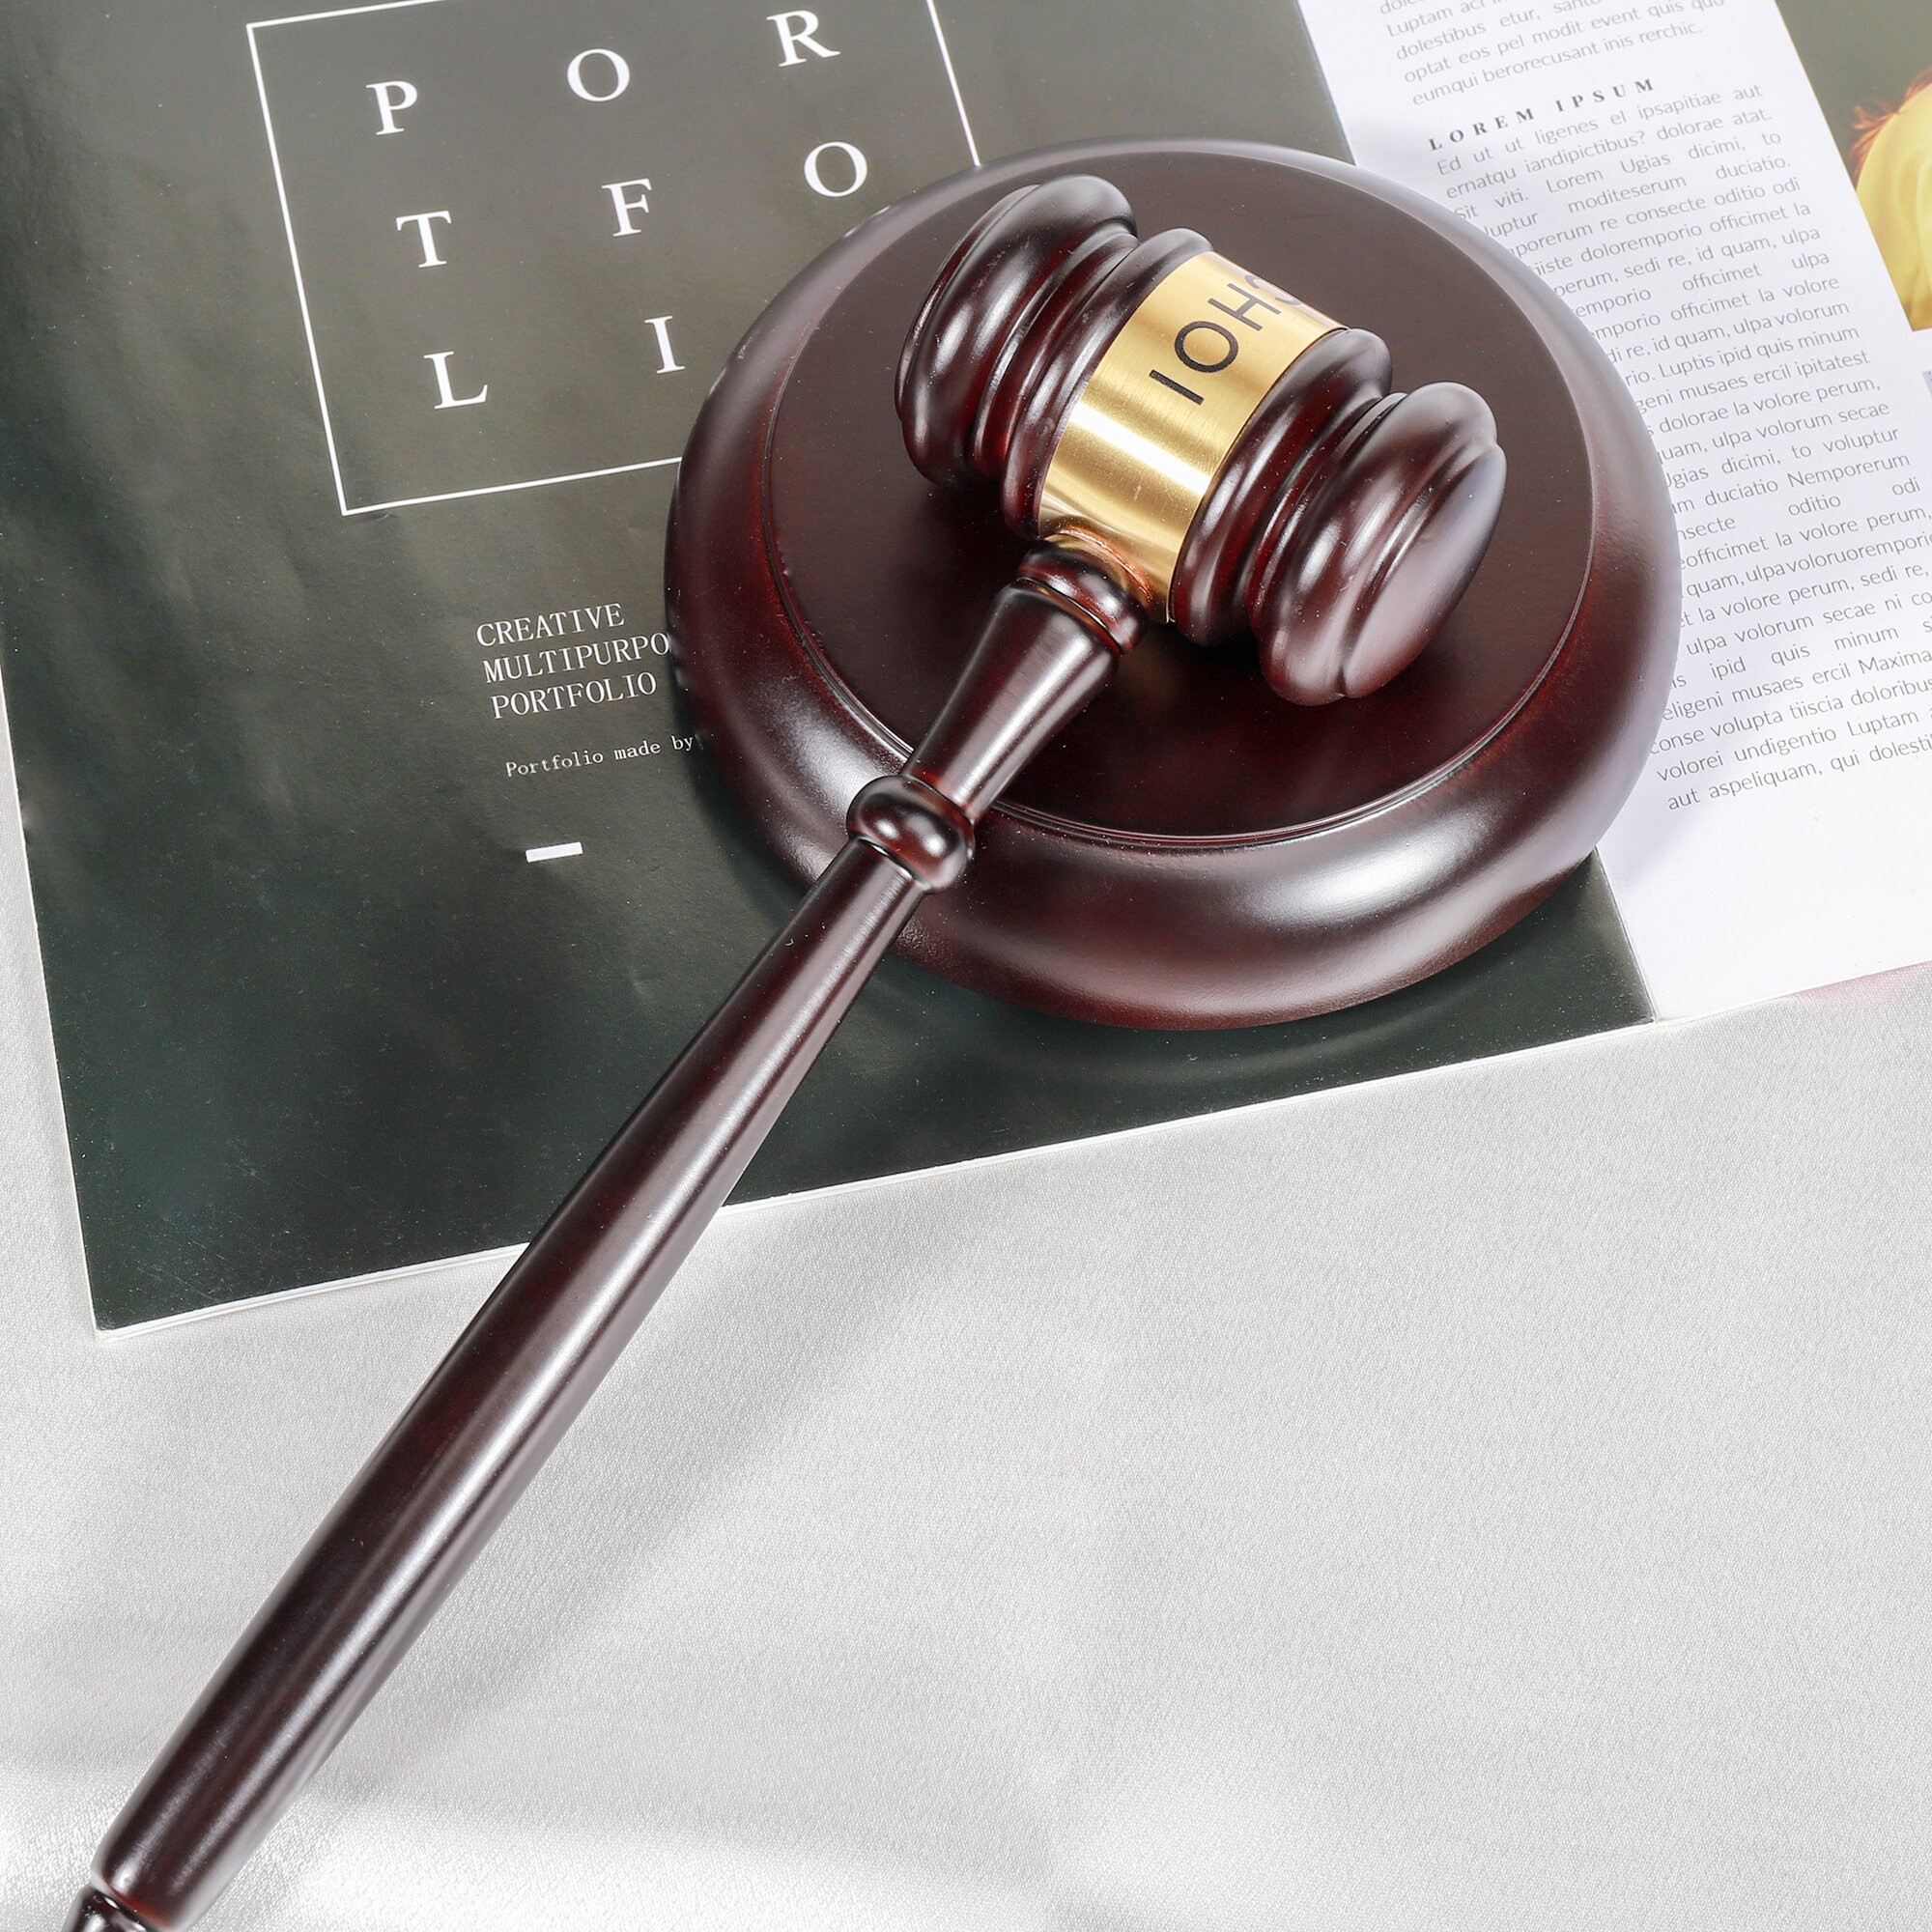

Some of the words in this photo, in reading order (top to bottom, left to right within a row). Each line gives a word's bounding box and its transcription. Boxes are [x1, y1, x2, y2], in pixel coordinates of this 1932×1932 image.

[1387, 8, 1453, 37] Luptam
[1396, 23, 1487, 60] dolestibus
[1499, 9, 1540, 27] etur,
[1405, 57, 1451, 82] optat
[1459, 47, 1491, 64] eos
[1497, 34, 1524, 56] pel
[1531, 20, 1583, 43] modit
[1591, 8, 1640, 29] event
[1647, 0, 1684, 18] quis
[366, 81, 417, 135] P
[567, 49, 630, 101] O
[766, 11, 840, 67] R
[1412, 72, 1479, 105] eumqui
[1482, 42, 1600, 82] berorecusant
[1603, 35, 1634, 51] inis
[1428, 107, 1534, 151] LOREM
[1555, 78, 1654, 112] IPSUM
[1436, 156, 1462, 176] Ed
[1473, 147, 1493, 162] ut
[1504, 137, 1524, 153] ut
[1534, 120, 1599, 145] ligenes
[1610, 109, 1627, 125] el
[1636, 93, 1721, 121] ipsapitiae
[1734, 85, 1762, 99] aut
[1446, 167, 1517, 199] ernatqu
[1524, 130, 1645, 173] iandipictibus?
[1657, 118, 1723, 140] dolorae
[1733, 108, 1772, 125] atat.
[1454, 204, 1479, 219] Sit
[1494, 187, 1529, 208] viti.
[1546, 170, 1604, 193] Lorem
[1619, 155, 1671, 174] Ugias
[1688, 136, 1746, 159] dicimi,
[1762, 132, 1781, 145] to
[396, 211, 451, 268] T
[602, 179, 651, 237] F
[804, 142, 867, 197] O
[1568, 177, 1687, 213] moditeserum
[1716, 156, 1791, 180] duciatio.
[1509, 224, 1593, 259] porerum
[1600, 218, 1619, 232] re
[1626, 198, 1707, 224] consecte
[1714, 185, 1766, 206] oditio
[1773, 177, 1801, 194] odi
[1580, 223, 1702, 263] doloremporio
[1709, 206, 1788, 232] officimet
[1793, 202, 1810, 216] la
[1624, 256, 1661, 278] sedi
[1667, 255, 1691, 268] re,
[1695, 244, 1715, 262] id
[1720, 238, 1776, 259] quam,
[1781, 229, 1820, 245] ulpa
[1572, 288, 1652, 318] emporio
[1682, 263, 1762, 291] officimet
[1791, 253, 1830, 270] ulpa
[1591, 313, 1661, 340] mporio
[1670, 292, 1751, 321] officimet
[1758, 288, 1776, 302] la
[1781, 278, 1839, 299] volore
[1626, 345, 1651, 359] re,
[1651, 335, 1670, 353] id
[1674, 327, 1731, 350] quam,
[1733, 317, 1773, 334] ulpa
[1774, 302, 1850, 326] volorum
[1658, 354, 1716, 378] Luptis
[1717, 344, 1752, 367] ipid
[1756, 337, 1794, 359] quis
[1797, 327, 1860, 349] minum
[424, 352, 488, 409] L
[644, 316, 685, 373] I
[1678, 376, 1748, 401] musaes
[1753, 363, 1792, 384] ercil
[1794, 350, 1870, 379] ipitatest
[1659, 408, 1729, 433] dolorae
[1732, 401, 1749, 416] la
[1752, 390, 1812, 412] volore
[1815, 379, 1881, 403] perum,
[1712, 430, 1752, 448] ulpa
[1755, 414, 1833, 439] volorum
[1837, 404, 1889, 423] secae
[1721, 448, 1781, 474] dicimi,
[1791, 444, 1811, 459] to
[1822, 429, 1898, 452] voluptur
[1705, 478, 1778, 506] duciatio
[1786, 455, 1911, 488] Nemporerum
[1788, 494, 1841, 516] oditio
[1891, 476, 1920, 496] odi
[1775, 531, 1793, 547] la
[1799, 520, 1859, 542] volore
[1866, 507, 1932, 532] perum,
[1698, 607, 1716, 622] la
[1720, 593, 1781, 616] volore
[1787, 579, 1855, 606] perum,
[1860, 565, 1898, 587] sedi
[1904, 564, 1929, 579] re,
[476, 603, 625, 646] CREATIVE
[1686, 636, 1729, 655] ulpa
[1732, 615, 1814, 642] volorum
[1822, 603, 1876, 624] secae
[1884, 593, 1903, 611] ni
[483, 632, 670, 684] MULTIPURPO
[1709, 656, 1747, 681] ipid
[1771, 643, 1810, 667] quis
[1833, 627, 1899, 651] minum
[1731, 676, 1804, 703] musaes
[1811, 662, 1851, 684] ercil
[492, 671, 657, 719] PORTFOLIO
[1708, 710, 1783, 737] volupta
[1789, 696, 1844, 719] tiiscia
[505, 751, 604, 777] Portfolio
[613, 740, 661, 760] made
[670, 735, 694, 752] by
[1656, 750, 1724, 781] volorei
[1732, 726, 1836, 762] undigentio
[1846, 711, 1919, 737] Luptam
[1667, 787, 1700, 810] aut
[1708, 763, 1823, 799] aspeliquam,
[1830, 750, 1861, 773] qui
[1868, 733, 1932, 762] dolesti
